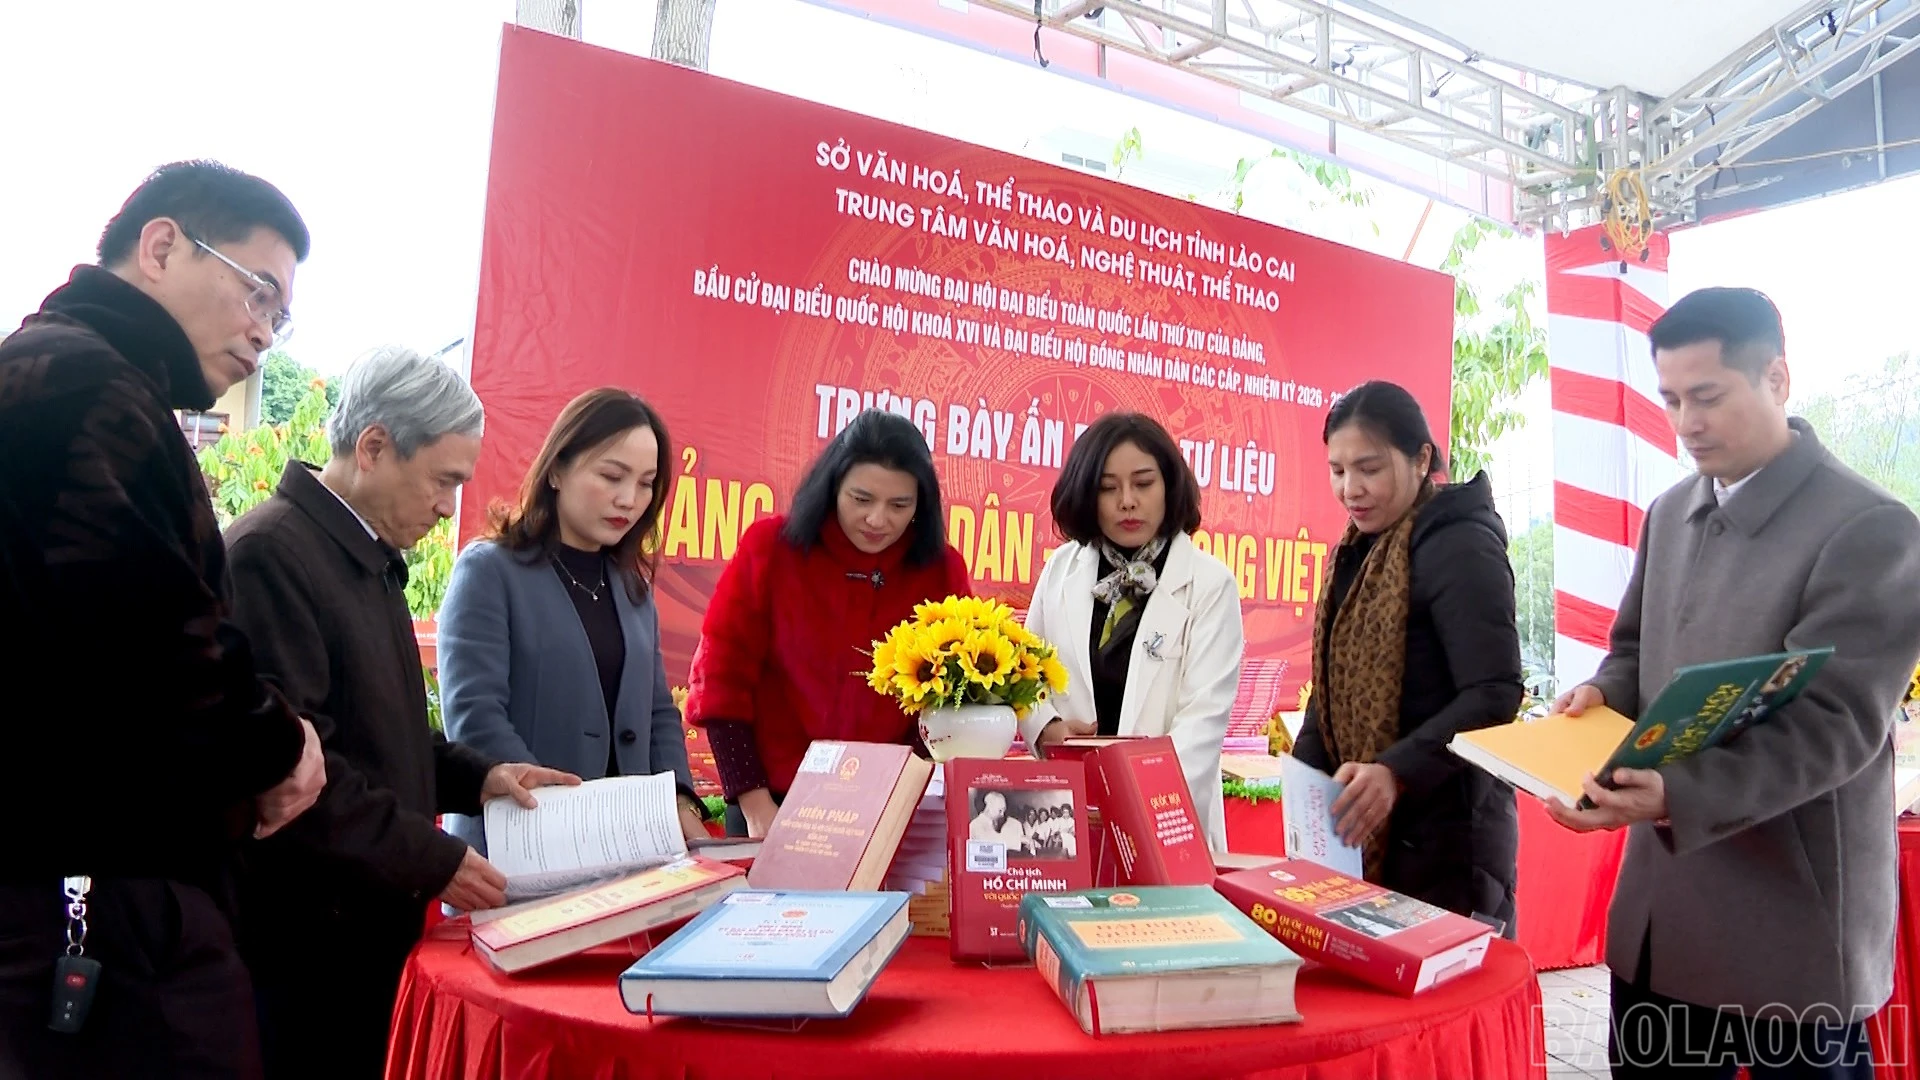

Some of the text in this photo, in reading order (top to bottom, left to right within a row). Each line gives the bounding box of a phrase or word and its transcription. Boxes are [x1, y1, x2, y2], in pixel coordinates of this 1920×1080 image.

[816, 137, 1295, 282] SỞ VĂN HOÁ, THỂ THAO VÀ DU LỊCH TỈNH LÀO CAI
[836, 188, 1280, 312] TRUNG TÂM VĂN HOÁ, NGHỆ THUẬT, THỂ THAO
[734, 271, 760, 305] CỬ
[761, 282, 791, 315] ĐẠI
[793, 282, 833, 319] BIỂU
[835, 293, 879, 328] QUỐC
[881, 303, 908, 336] HỘI
[911, 312, 952, 340] KHOÁ
[955, 319, 980, 345] XVI
[983, 321, 1001, 349] VÀ
[1004, 327, 1028, 358] ĐẠI
[1031, 327, 1062, 360] BIỂU
[1064, 337, 1087, 368] HỘI
[1127, 351, 1163, 378] NHÂN
[1165, 356, 1190, 384] DÂN
[1192, 361, 1216, 389] CÁC
[1217, 364, 1242, 396] CẤP,
[1244, 373, 1280, 402] NHIỆM
[1281, 379, 1296, 402] KỲ
[1297, 384, 1322, 408] 2026
[849, 257, 892, 289] CHÀO
[895, 265, 941, 299] MỪNG
[944, 277, 969, 308] ĐẠI
[972, 281, 997, 313] HỘI
[1000, 289, 1024, 318] ĐẠI
[1026, 289, 1058, 322] BIỂU
[1061, 301, 1095, 329] TOÀN
[1098, 307, 1132, 337] QUỐC
[1161, 321, 1185, 347] THỨ
[1185, 327, 1206, 350] XIV
[1207, 328, 1230, 356] CỦA
[1232, 333, 1266, 366] ĐẢNG,
[947, 397, 1014, 461] BÀY
[1021, 397, 1064, 468] ẤN
[1219, 440, 1276, 503] LIỆU
[949, 493, 1034, 584] DÂN
[1265, 527, 1327, 616] VIỆT
[1006, 877, 1029, 890] CHÍ
[1031, 879, 1067, 890] MINH
[1251, 903, 1278, 925] 80
